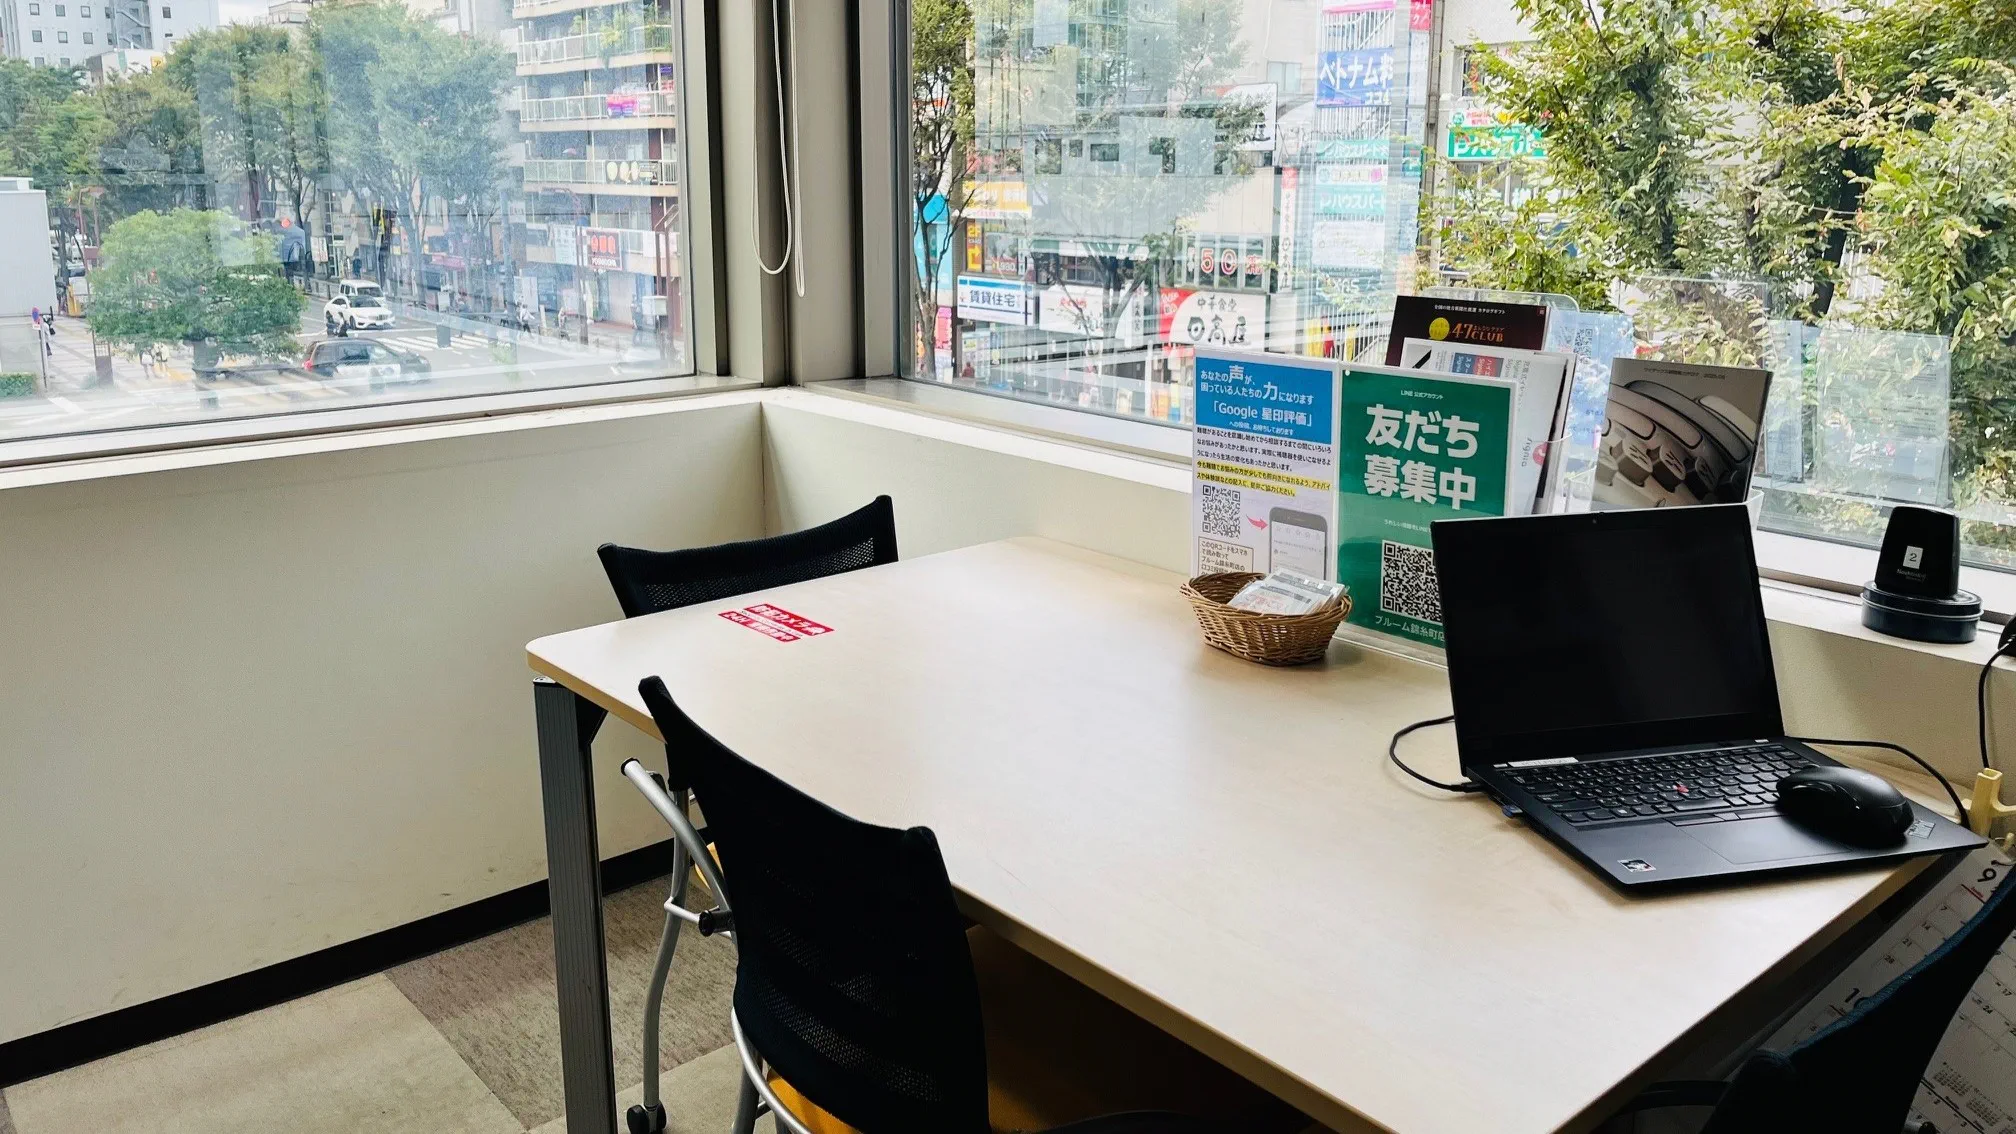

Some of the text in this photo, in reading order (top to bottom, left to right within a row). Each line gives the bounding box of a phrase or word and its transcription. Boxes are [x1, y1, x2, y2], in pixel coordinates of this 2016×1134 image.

[969, 289, 1016, 308] 賃貸住宅
[1200, 365, 1256, 386] あなたの声が、
[1200, 381, 1314, 405] 困っている人たちの力になります
[1213, 400, 1312, 427] 「Google 星印評価」
[1365, 404, 1480, 459] 友だち
[1364, 453, 1477, 511] 募集中
[1909, 553, 1917, 562] 2
[1902, 938, 1913, 947] 21
